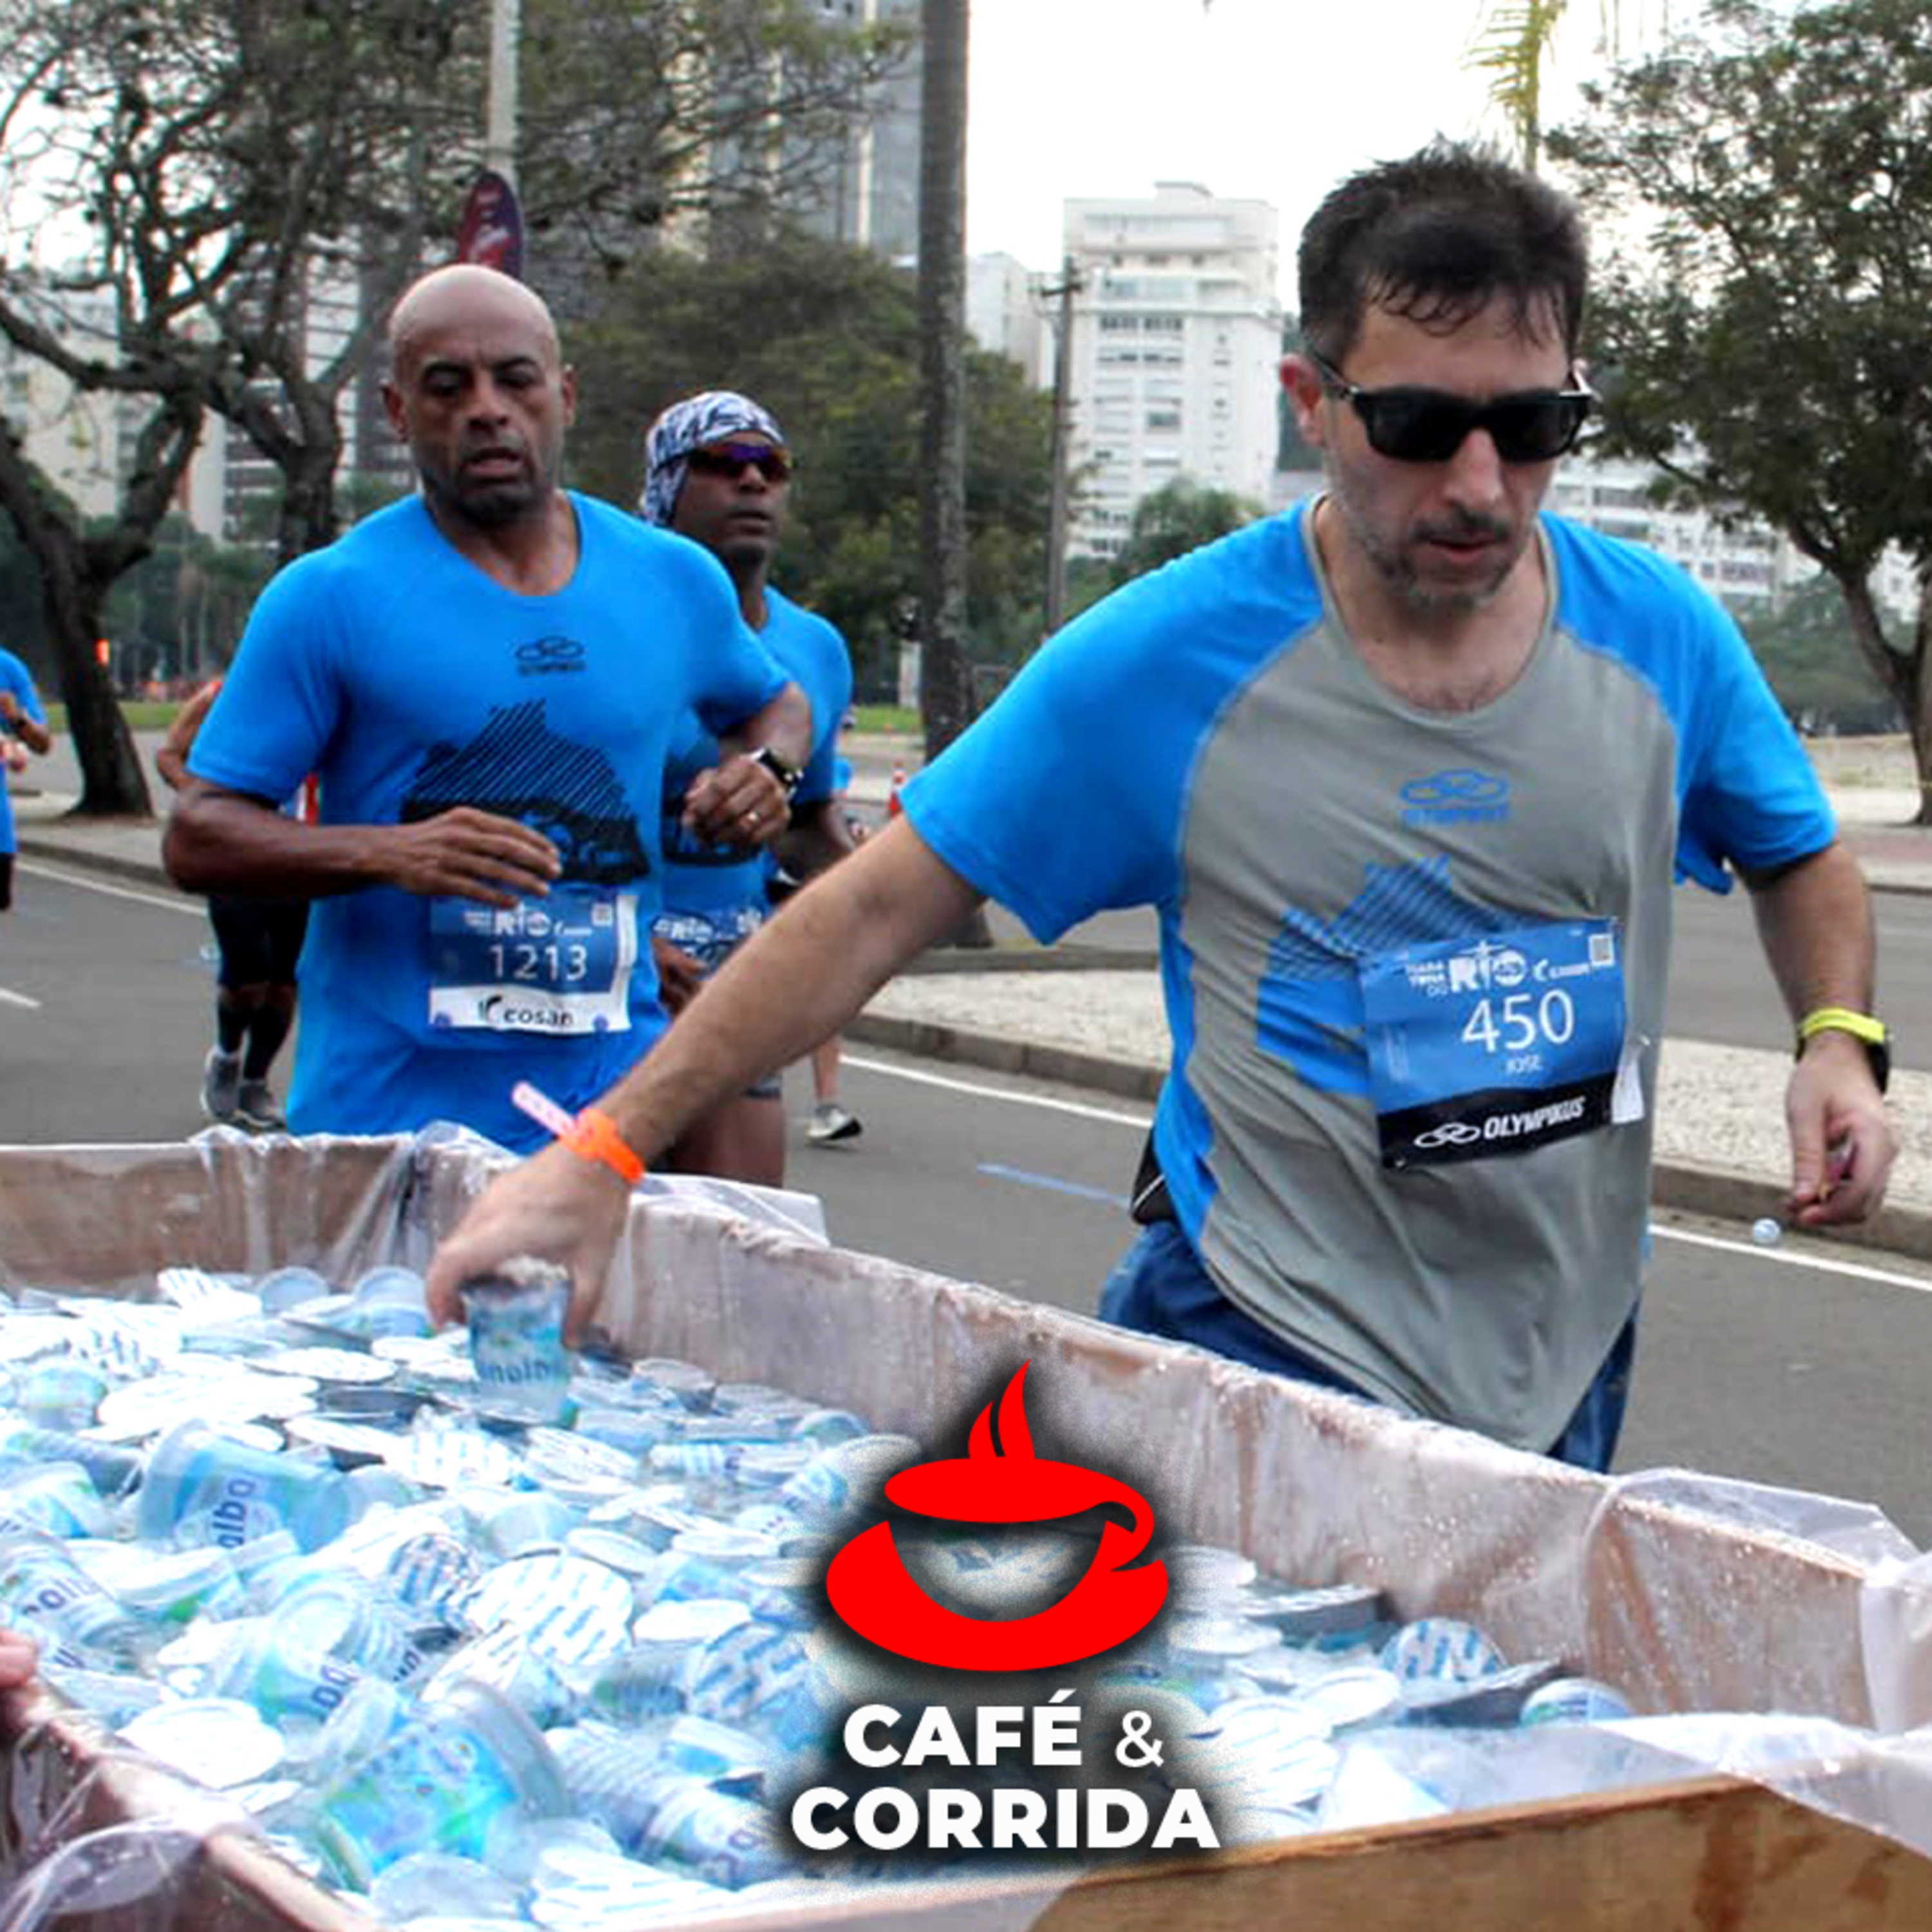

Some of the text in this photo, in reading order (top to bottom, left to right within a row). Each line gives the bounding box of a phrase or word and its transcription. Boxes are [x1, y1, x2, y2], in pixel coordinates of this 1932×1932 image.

[489, 943, 588, 981] 1213
[504, 1009, 574, 1026] cosan
[1461, 989, 1575, 1053] 450
[1483, 1095, 1586, 1140] OLYMPIKUS
